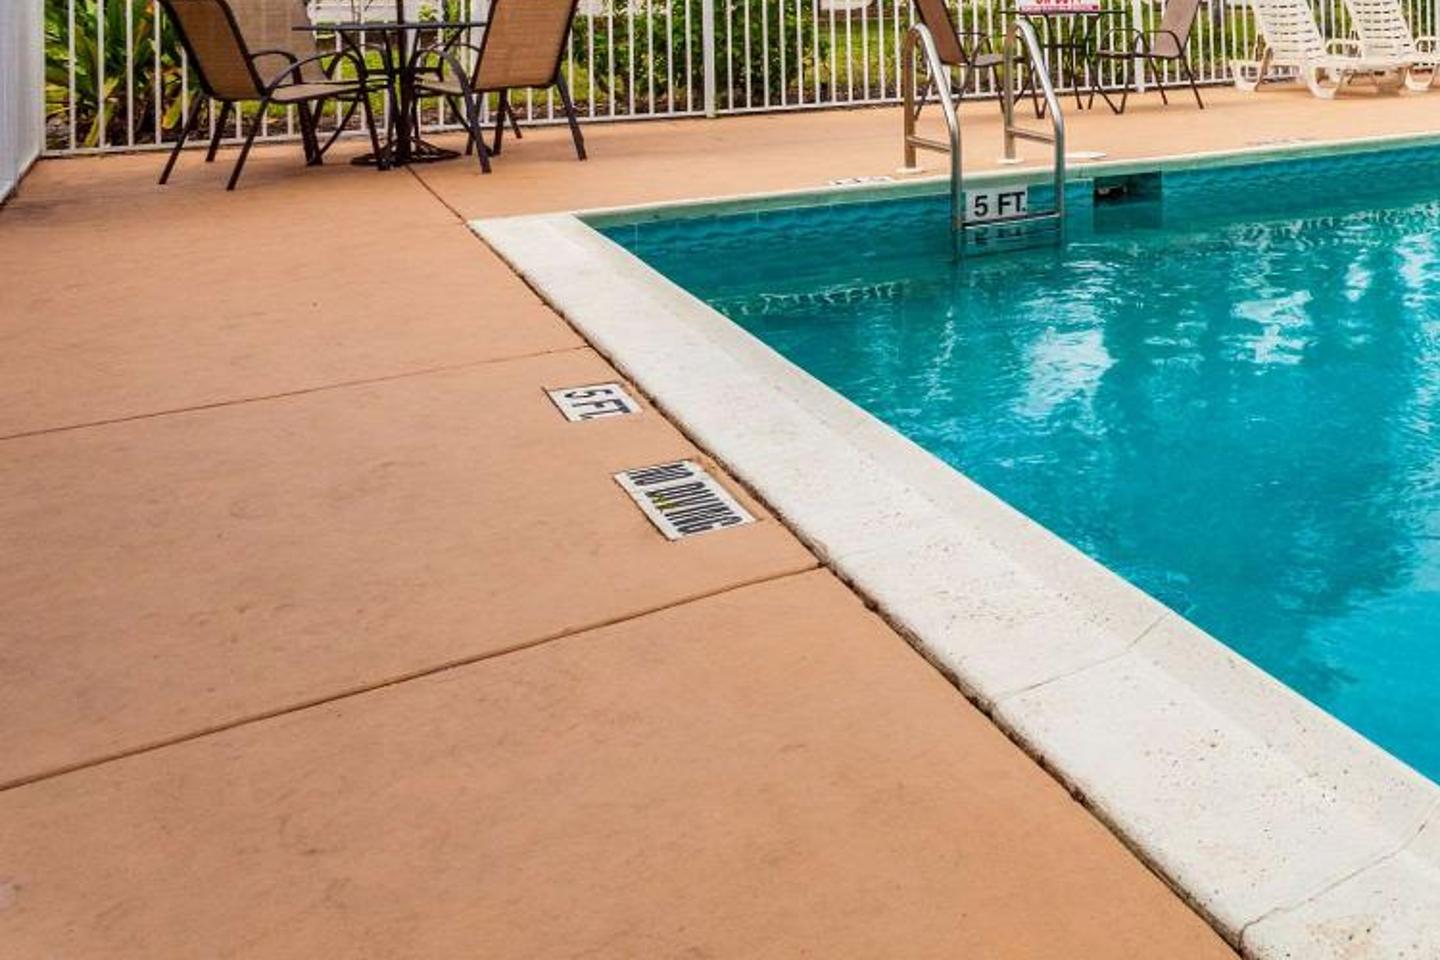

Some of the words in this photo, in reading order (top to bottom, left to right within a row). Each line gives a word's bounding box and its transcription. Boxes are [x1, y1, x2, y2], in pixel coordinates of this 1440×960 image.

[974, 195, 989, 217] 5
[998, 191, 1026, 215] FT.
[564, 389, 614, 398] 5
